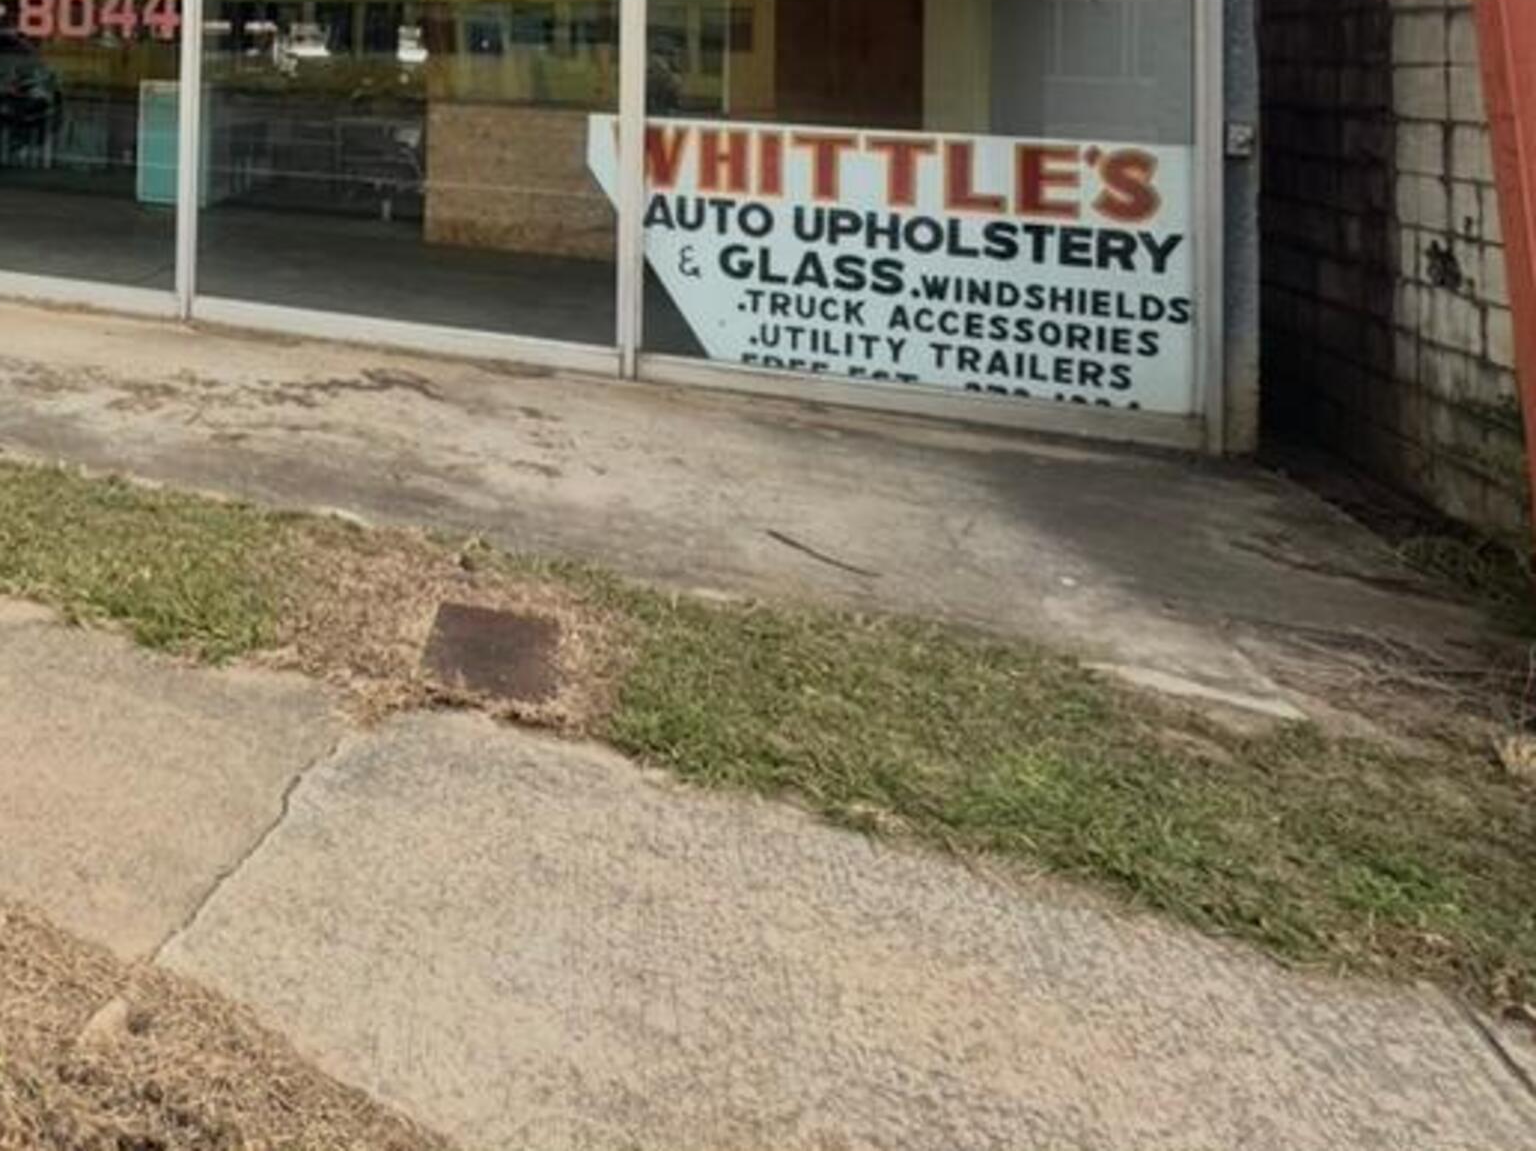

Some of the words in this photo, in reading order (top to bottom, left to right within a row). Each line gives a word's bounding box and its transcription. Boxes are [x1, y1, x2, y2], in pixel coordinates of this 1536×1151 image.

[644, 194, 774, 237] AUTO
[793, 205, 1183, 274] UPHOLSTERY
[719, 243, 905, 295] GLASS
[889, 304, 1161, 357] ACCESSORIES
[929, 342, 1133, 391] TRAILERS
